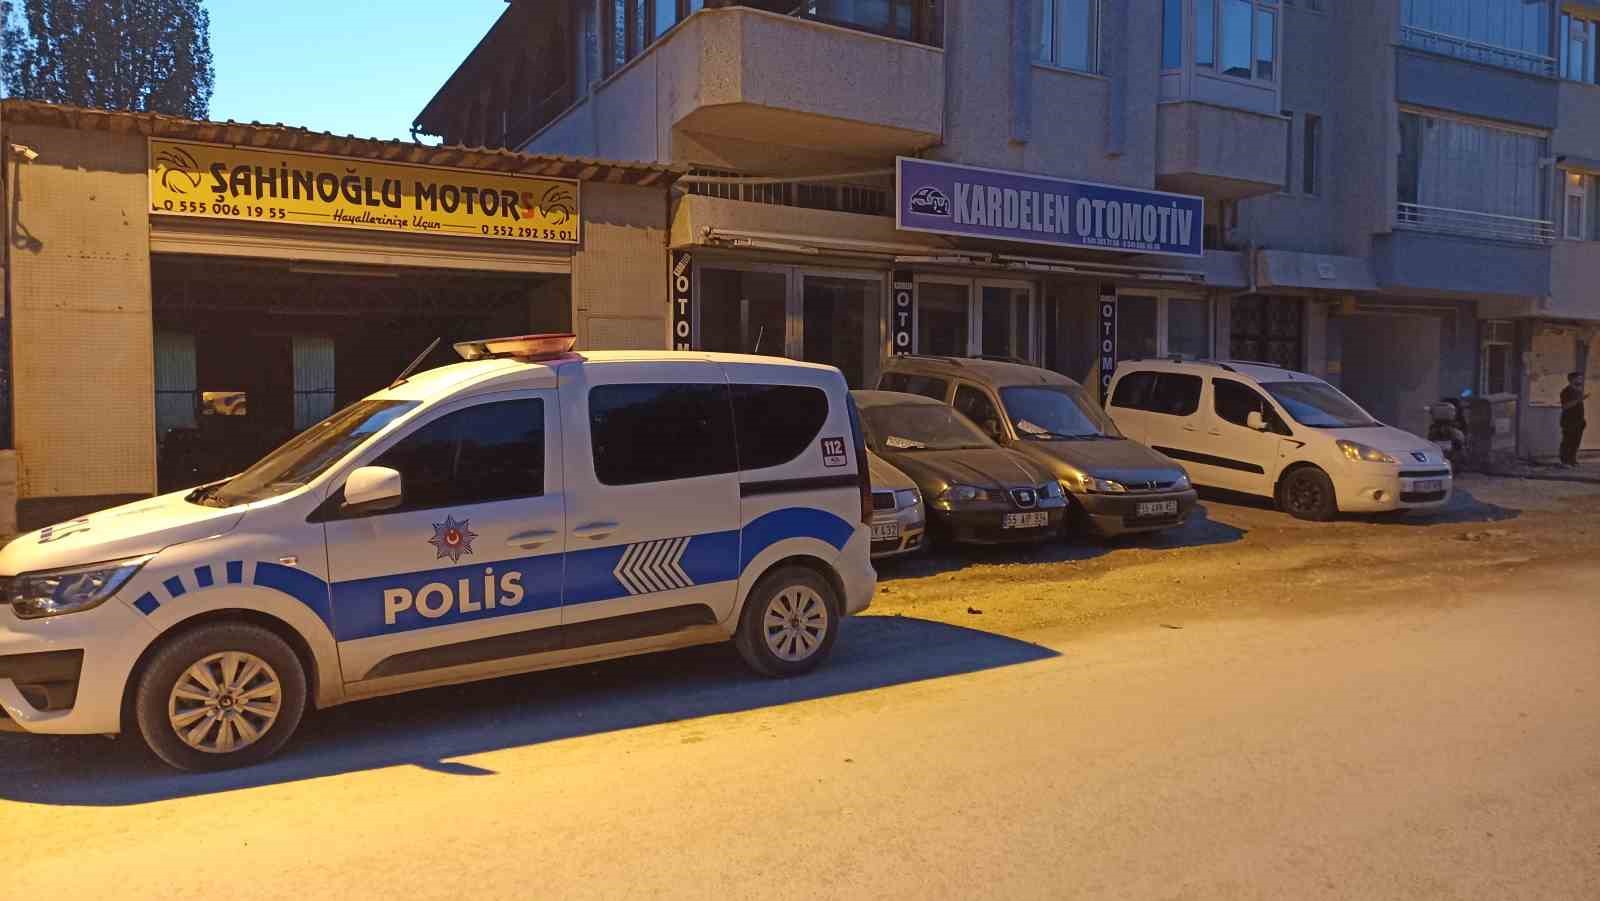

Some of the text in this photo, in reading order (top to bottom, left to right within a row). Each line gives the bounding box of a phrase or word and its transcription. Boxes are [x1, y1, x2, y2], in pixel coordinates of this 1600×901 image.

[164, 200, 286, 219] 0 555 006 19 55
[209, 161, 535, 221] ŞAHİNOĞLU MOTORS
[333, 208, 441, 229] Hayallerinize Uçun
[481, 224, 571, 240] 0 552 292 55 01
[954, 182, 1193, 246] KARDELEN OTOMOTİV
[896, 292, 909, 356] OTO
[824, 440, 843, 455] 112
[383, 566, 525, 625] POLİS
